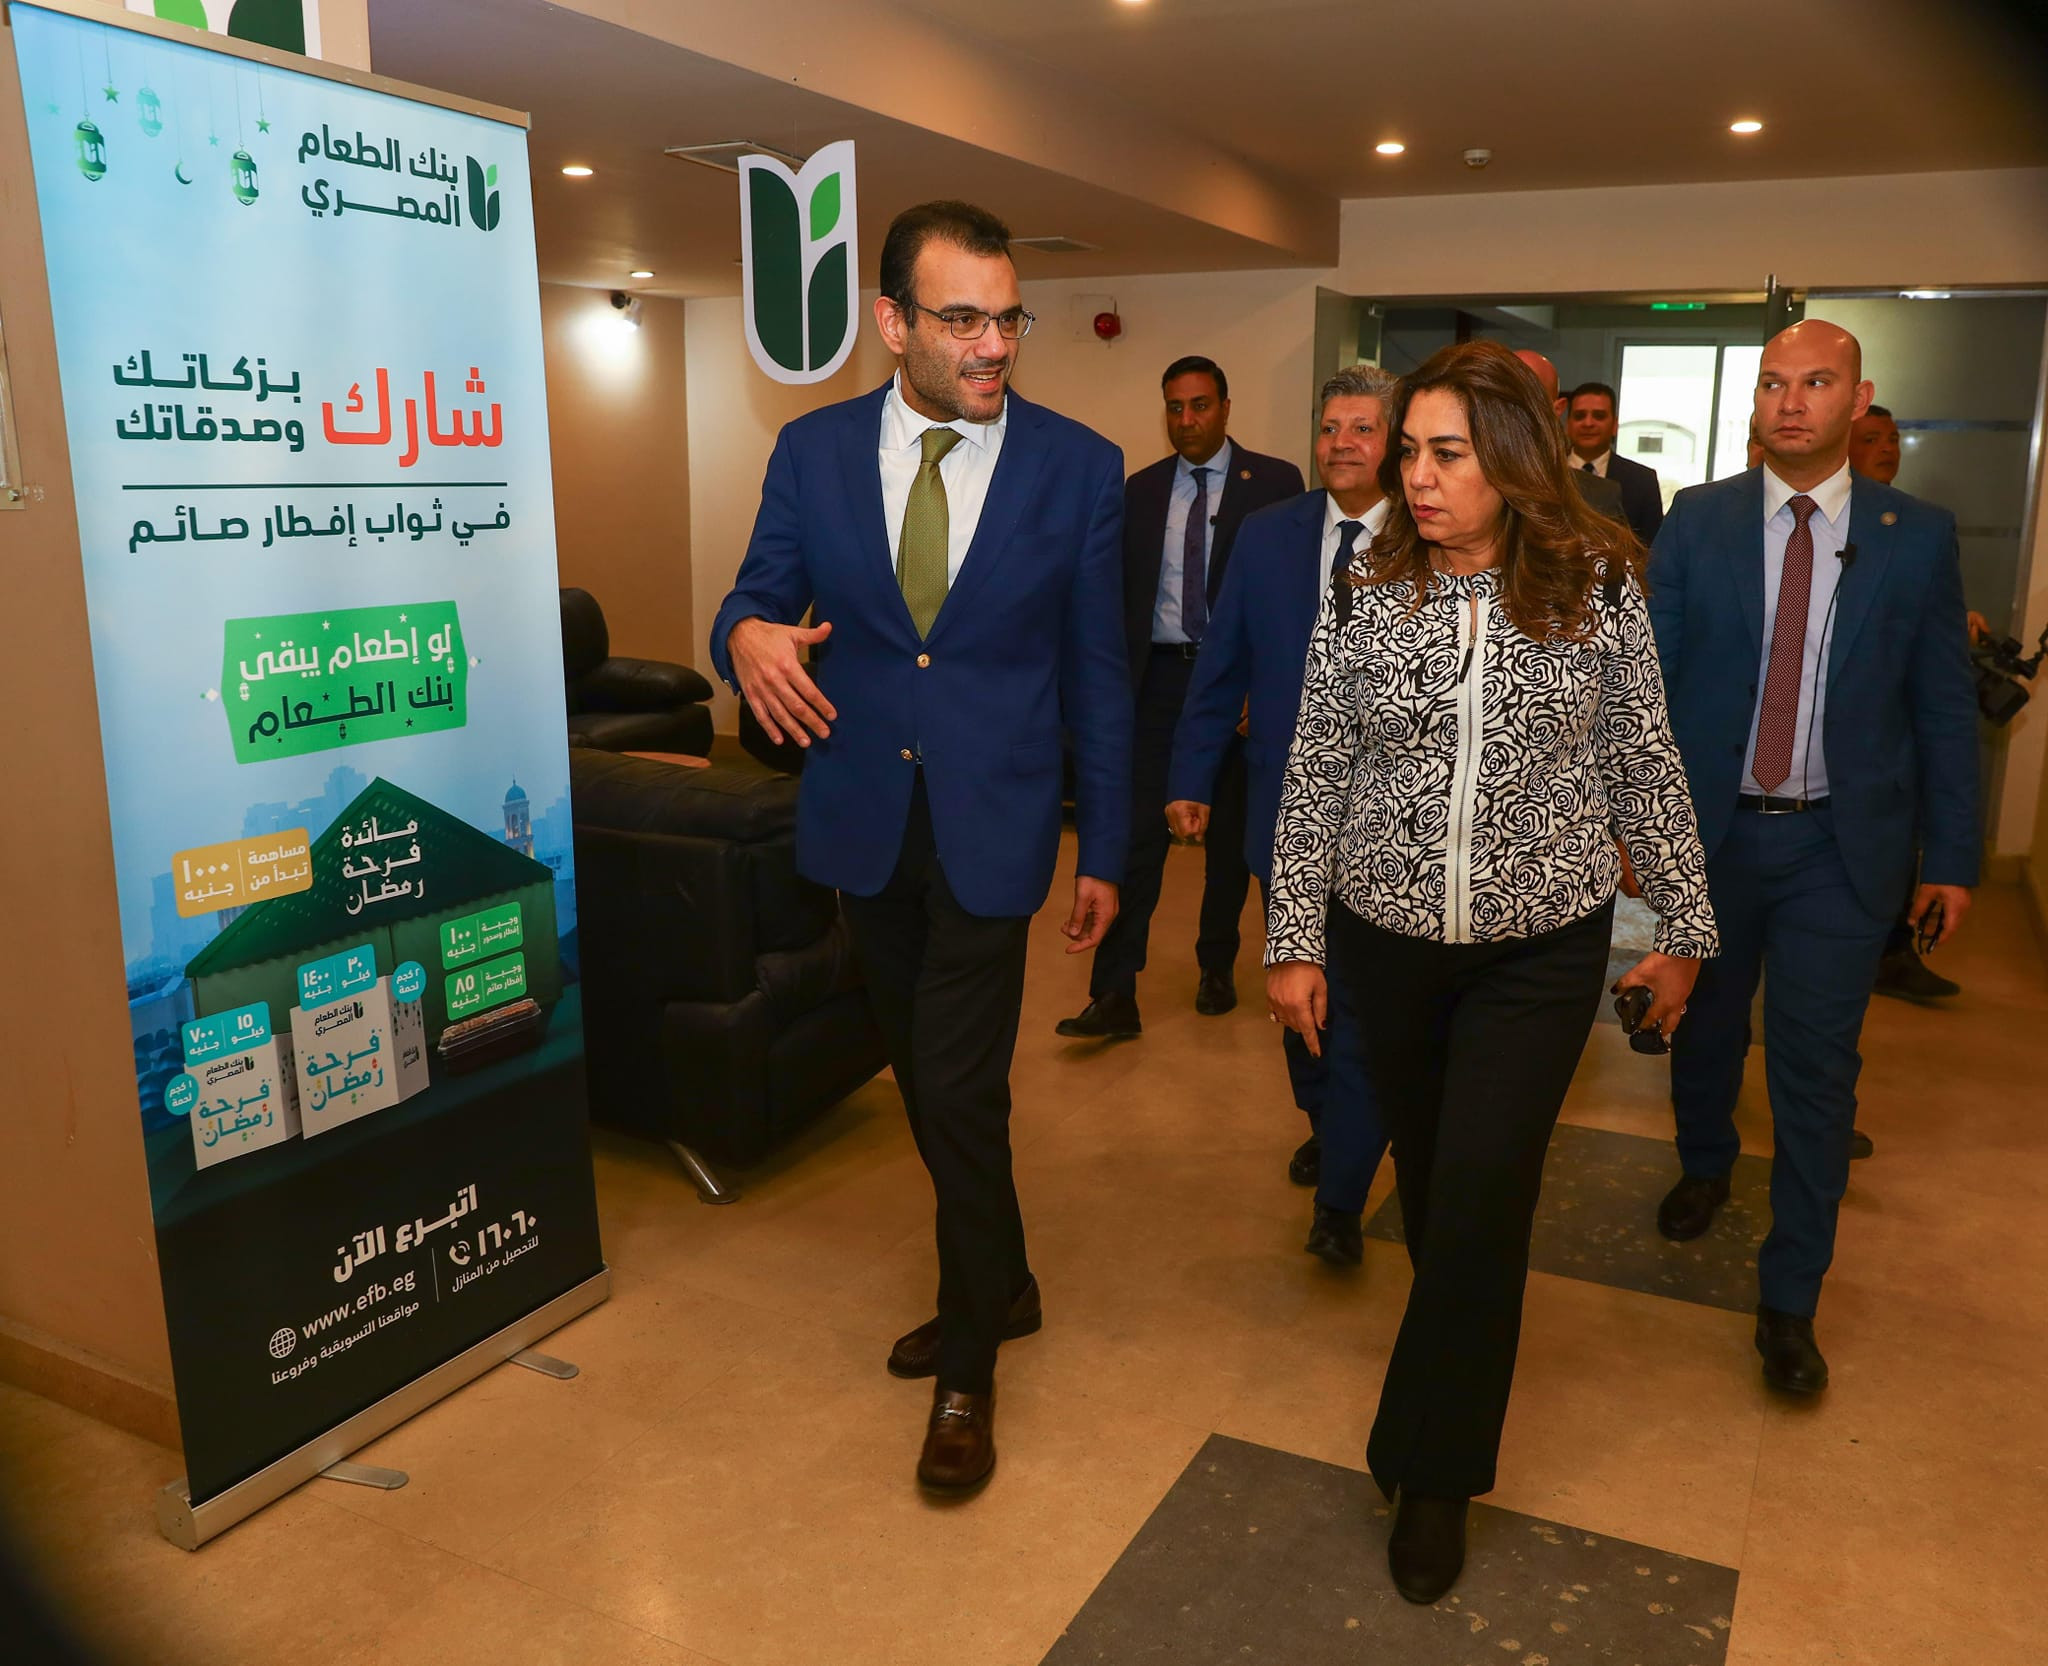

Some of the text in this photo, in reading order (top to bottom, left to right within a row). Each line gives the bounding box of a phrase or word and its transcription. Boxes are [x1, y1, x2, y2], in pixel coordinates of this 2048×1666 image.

[298, 124, 458, 191] بنك الطعام
[302, 178, 460, 227] المصري
[112, 350, 301, 403] بزكاتك
[115, 403, 305, 453] وصدقاتك
[321, 366, 503, 468] شارك
[129, 497, 511, 553] في ثواب إفطار صائم
[329, 627, 420, 675] إطعام
[428, 624, 451, 662] لو
[249, 675, 453, 744] بنك الطعام
[341, 816, 418, 848] مائدة
[248, 845, 306, 865] مساهمة
[342, 838, 421, 879] فرحة
[183, 860, 230, 884] ١٠٠٠
[250, 862, 308, 891] تبدأ من
[184, 882, 234, 903] جنيه
[346, 878, 424, 915] رمضان
[481, 916, 518, 932] وجبة
[483, 926, 519, 944] إفطار وسحور
[451, 927, 471, 945] ١٠٠
[447, 942, 476, 958] جنيه
[303, 969, 330, 988] ١٤٠٠
[341, 969, 371, 988] كيلو
[396, 969, 414, 984] كجم
[485, 964, 522, 981] وجبة
[504, 974, 523, 989] إفطار
[304, 984, 332, 1000] جنيه
[399, 982, 419, 994] لحمة
[456, 974, 475, 995] ٨٥
[452, 994, 480, 1009] جنيه
[237, 1013, 253, 1030] ١٥
[314, 1005, 352, 1026] بنك الطعام
[315, 1013, 354, 1036] المصري
[189, 1027, 214, 1043] ٧٠٠
[231, 1025, 265, 1045] كيلو
[189, 1040, 220, 1056] جنيه
[306, 1028, 380, 1078] فرحة
[206, 1057, 243, 1077] بنك الطعام
[206, 1067, 244, 1086] المصري
[169, 1082, 186, 1098] كجم
[171, 1093, 192, 1108] لحمة
[198, 1078, 270, 1119] فرحة
[310, 1067, 383, 1112] رمضان
[203, 1111, 273, 1147] رمضان
[333, 1183, 478, 1283] اتبرع الآن
[478, 1210, 537, 1257] ١٦٠٦٠
[451, 1236, 539, 1293] للتحصيل من المنازل
[302, 1270, 416, 1339] www.efb.eg
[271, 1301, 420, 1385] مواقعنا التسويقية وفروعنا
